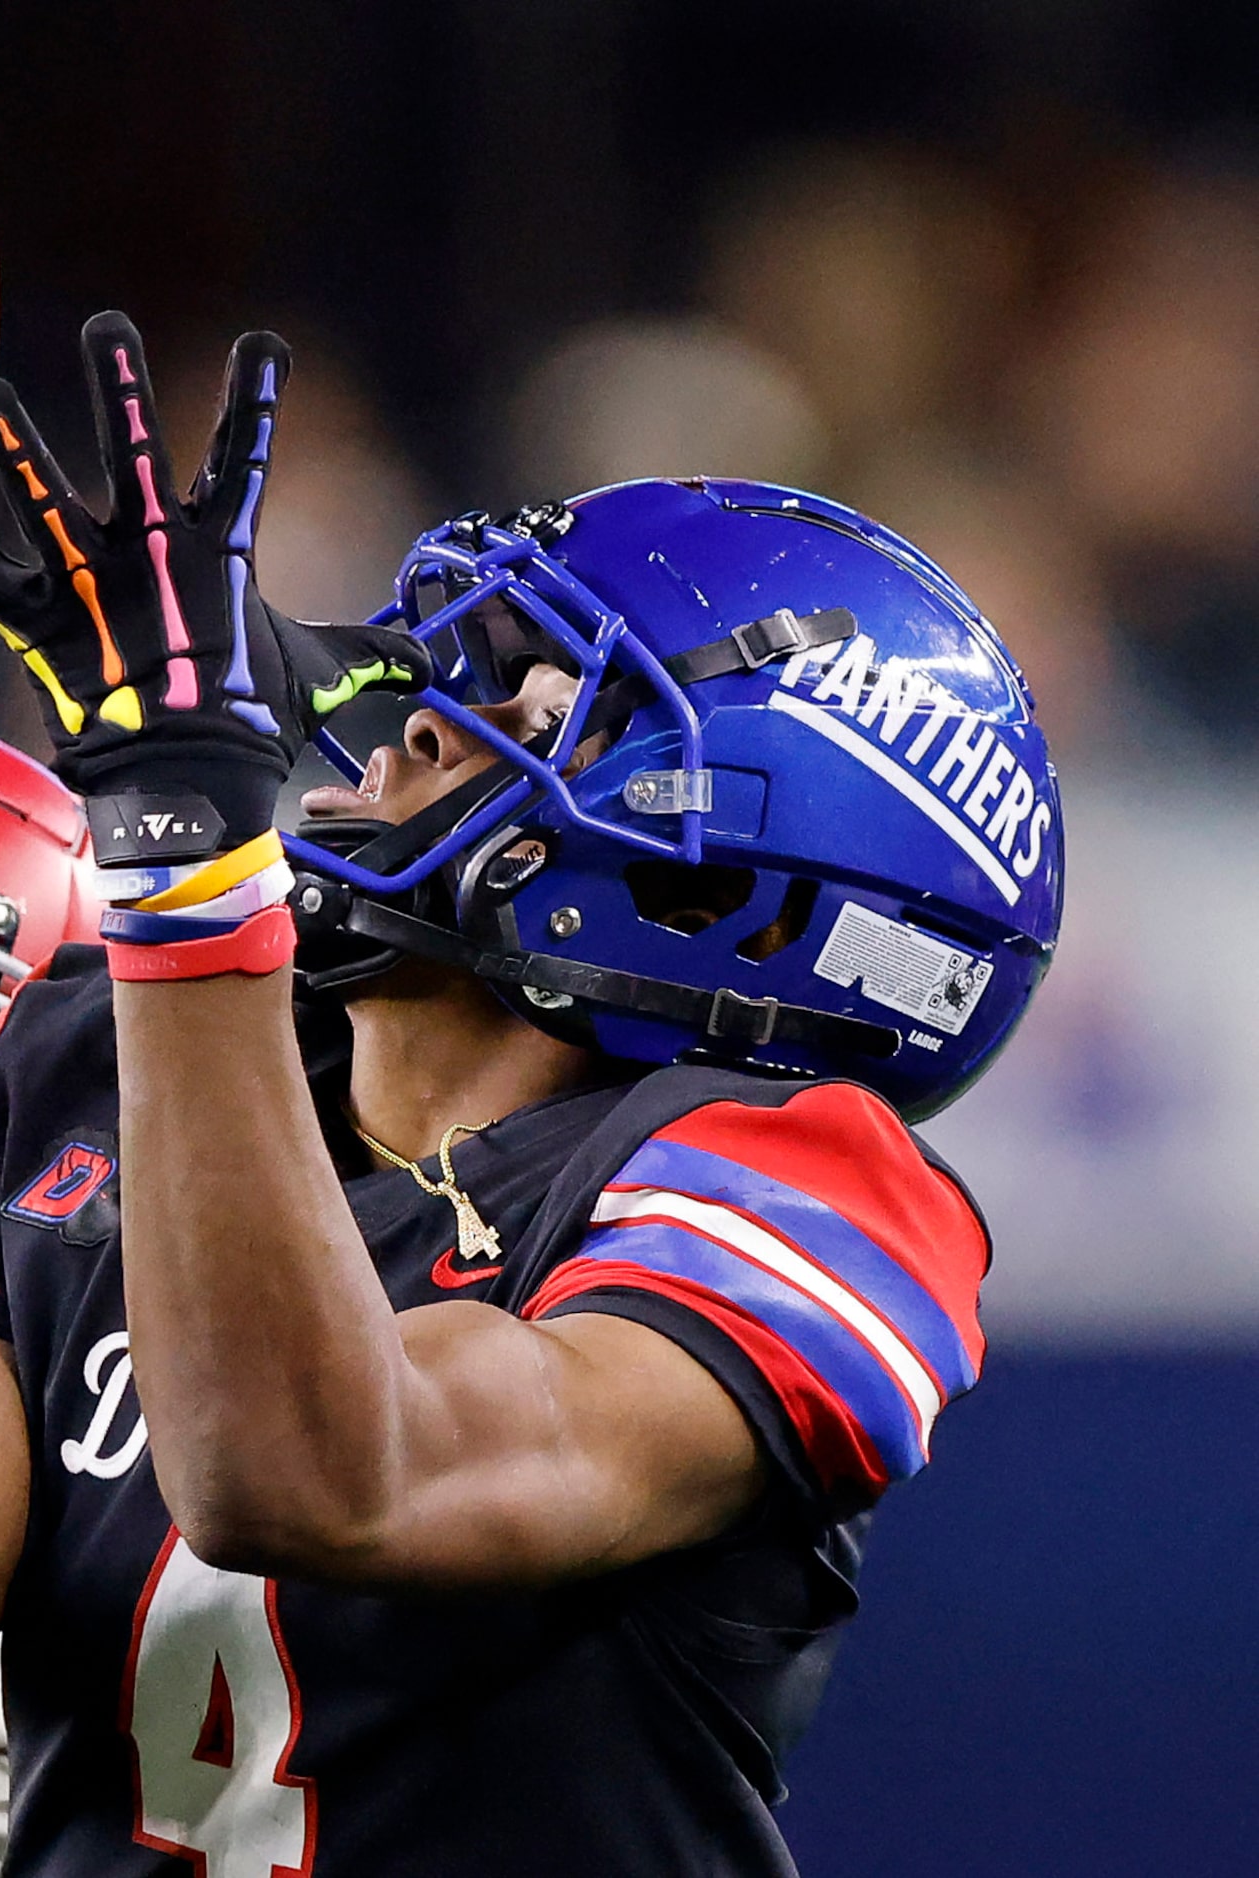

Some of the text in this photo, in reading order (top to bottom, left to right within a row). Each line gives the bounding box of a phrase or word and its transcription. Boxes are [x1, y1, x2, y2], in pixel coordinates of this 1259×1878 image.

[779, 633, 1051, 880] PANTHERS
[113, 813, 204, 841] RIVEL
[908, 1029, 943, 1052] LARGE
[118, 1523, 318, 1878] 4
